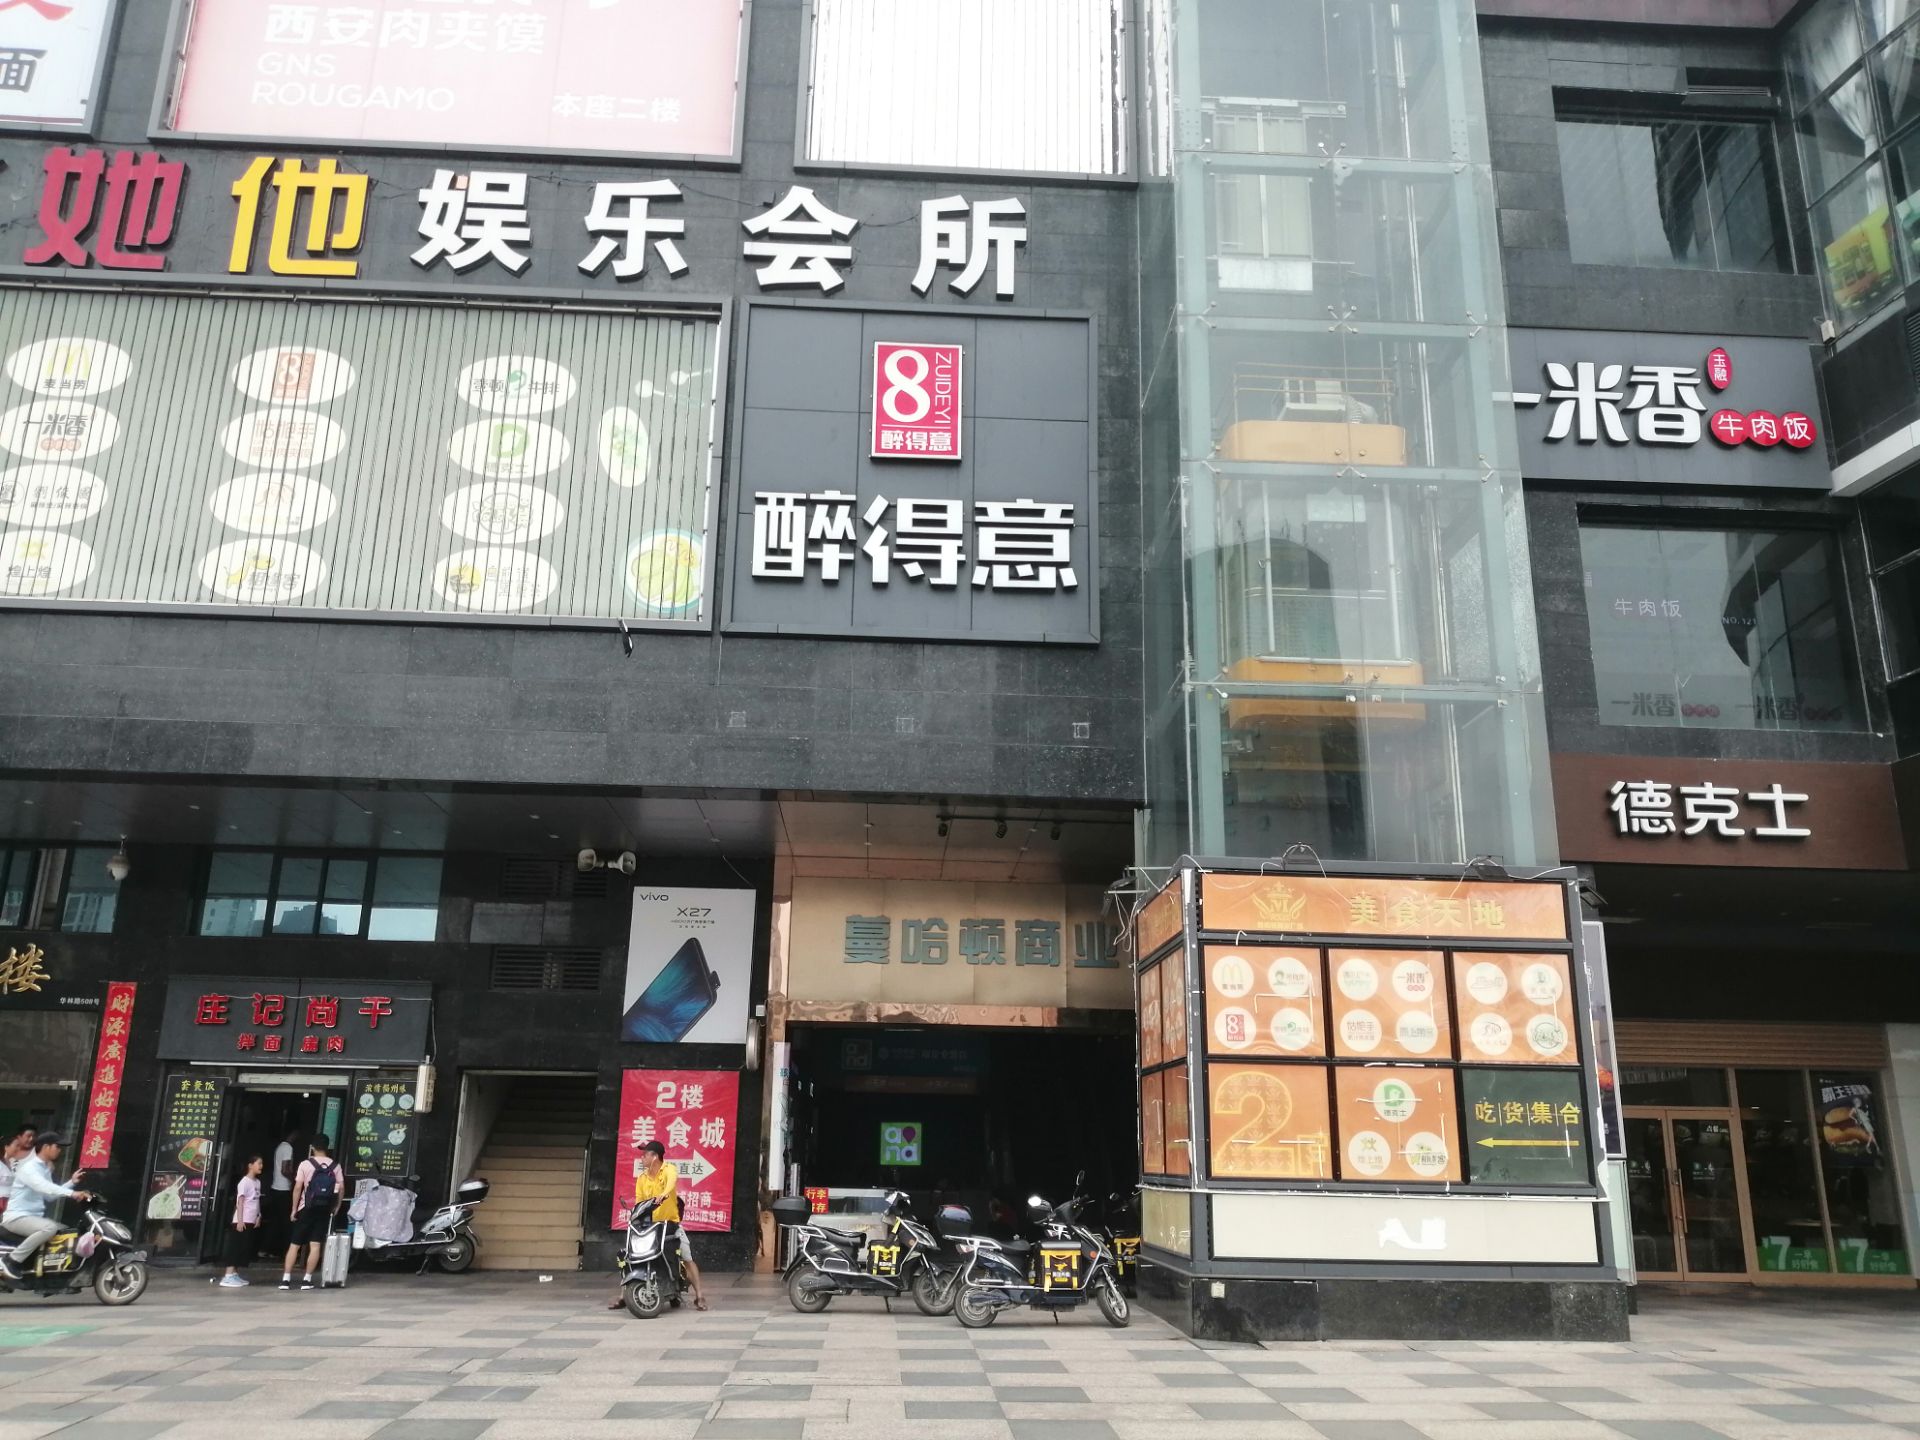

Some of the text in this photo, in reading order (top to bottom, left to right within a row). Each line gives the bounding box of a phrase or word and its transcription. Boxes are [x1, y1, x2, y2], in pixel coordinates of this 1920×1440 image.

[264, 4, 548, 54] 西安肉夹馍
[257, 52, 337, 77] GNS
[251, 81, 455, 112] ROUGAMO
[552, 93, 681, 123] 本座二楼
[882, 349, 952, 424] 8 ZUIDEYI
[1492, 361, 1706, 444] 一米香
[23, 413, 89, 436] 一米香
[1718, 414, 1811, 440] 牛肉饭
[881, 429, 952, 451] 醉得意
[752, 490, 1078, 589] 醉得意
[1614, 598, 1683, 618] 牛肉饭
[1611, 692, 1677, 717] 一米香
[1610, 780, 1812, 837] 德克士
[640, 892, 669, 902] vivo
[1350, 891, 1506, 930] 美食天地
[677, 907, 712, 917] X27
[844, 915, 1120, 969] 曼哈顿商业
[656, 1081, 704, 1110] 2楼
[1475, 1101, 1581, 1125] 吃货集合
[631, 1116, 726, 1149] 美食城
